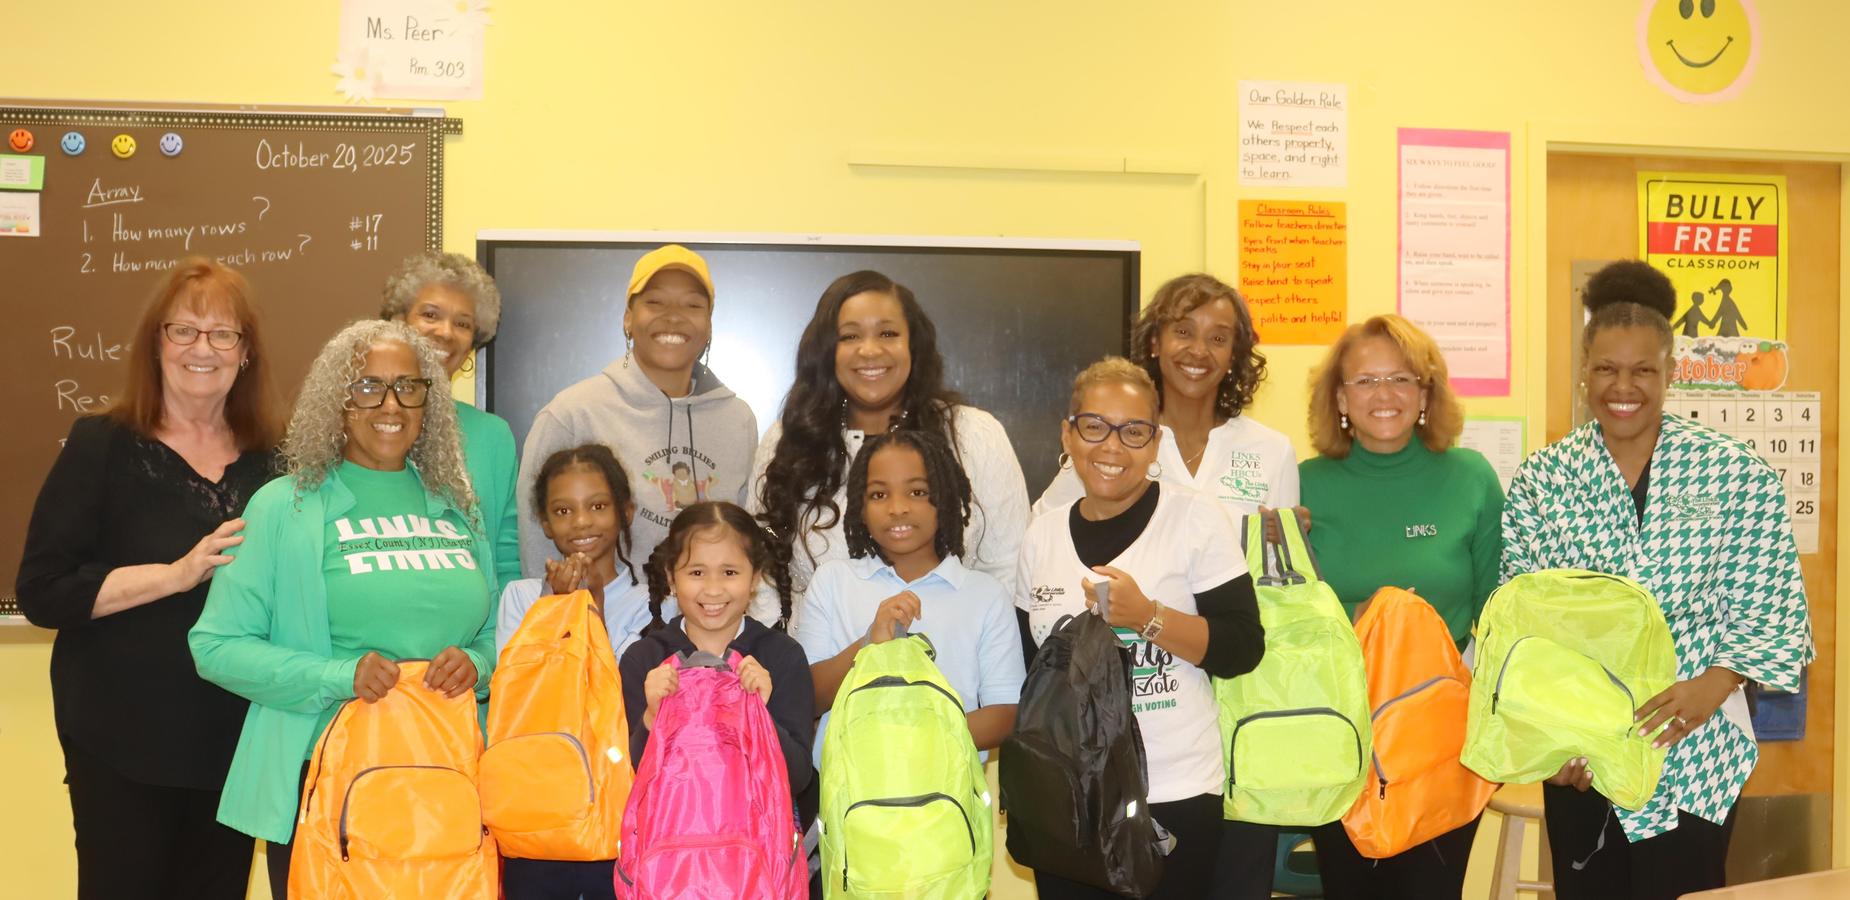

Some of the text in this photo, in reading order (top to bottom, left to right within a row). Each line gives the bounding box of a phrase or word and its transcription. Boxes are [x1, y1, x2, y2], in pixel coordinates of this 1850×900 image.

[405, 16, 444, 41] Peer
[434, 61, 465, 78] 303
[1250, 89, 1341, 108] Our Golden Rule
[1248, 120, 1339, 135] We Respect each
[1242, 134, 1280, 146] others
[256, 139, 416, 172] October 20, 2025
[1285, 155, 1306, 163] and
[1311, 154, 1338, 168] right
[1243, 167, 1254, 177] to
[88, 178, 140, 204] Array
[1666, 194, 1765, 220] BULLY
[349, 214, 383, 232] #17
[1244, 219, 1272, 228] Follow
[112, 213, 141, 242] How
[149, 226, 195, 250] many
[201, 221, 246, 235] rows
[1674, 226, 1753, 252] FREE
[81, 253, 95, 273] 2.
[112, 252, 141, 272] How
[145, 259, 178, 271] man
[261, 249, 292, 262] row
[1242, 260, 1259, 272] Stay
[1296, 256, 1315, 268] seat
[1667, 258, 1760, 269] CLASSROOM
[1293, 275, 1302, 285] to
[1305, 274, 1333, 288] speak
[1285, 292, 1318, 304] others
[1261, 312, 1288, 327] polite
[1291, 314, 1307, 323] and
[1672, 354, 1747, 382] ctober
[55, 379, 110, 412] Res
[1721, 409, 1727, 422] 1
[1746, 408, 1755, 421] 2
[1774, 408, 1783, 422] 3
[1801, 408, 1810, 421] 4
[1770, 439, 1787, 453] 10
[1799, 439, 1815, 453] 11
[644, 446, 716, 470] SMILING BELLIES
[1801, 472, 1814, 486] 18
[1796, 500, 1814, 515] 25
[640, 508, 673, 529] HEALT
[1406, 524, 1437, 537] LINKS
[340, 541, 373, 552] Essex
[375, 538, 411, 549] County
[1145, 699, 1177, 711] VOTING
